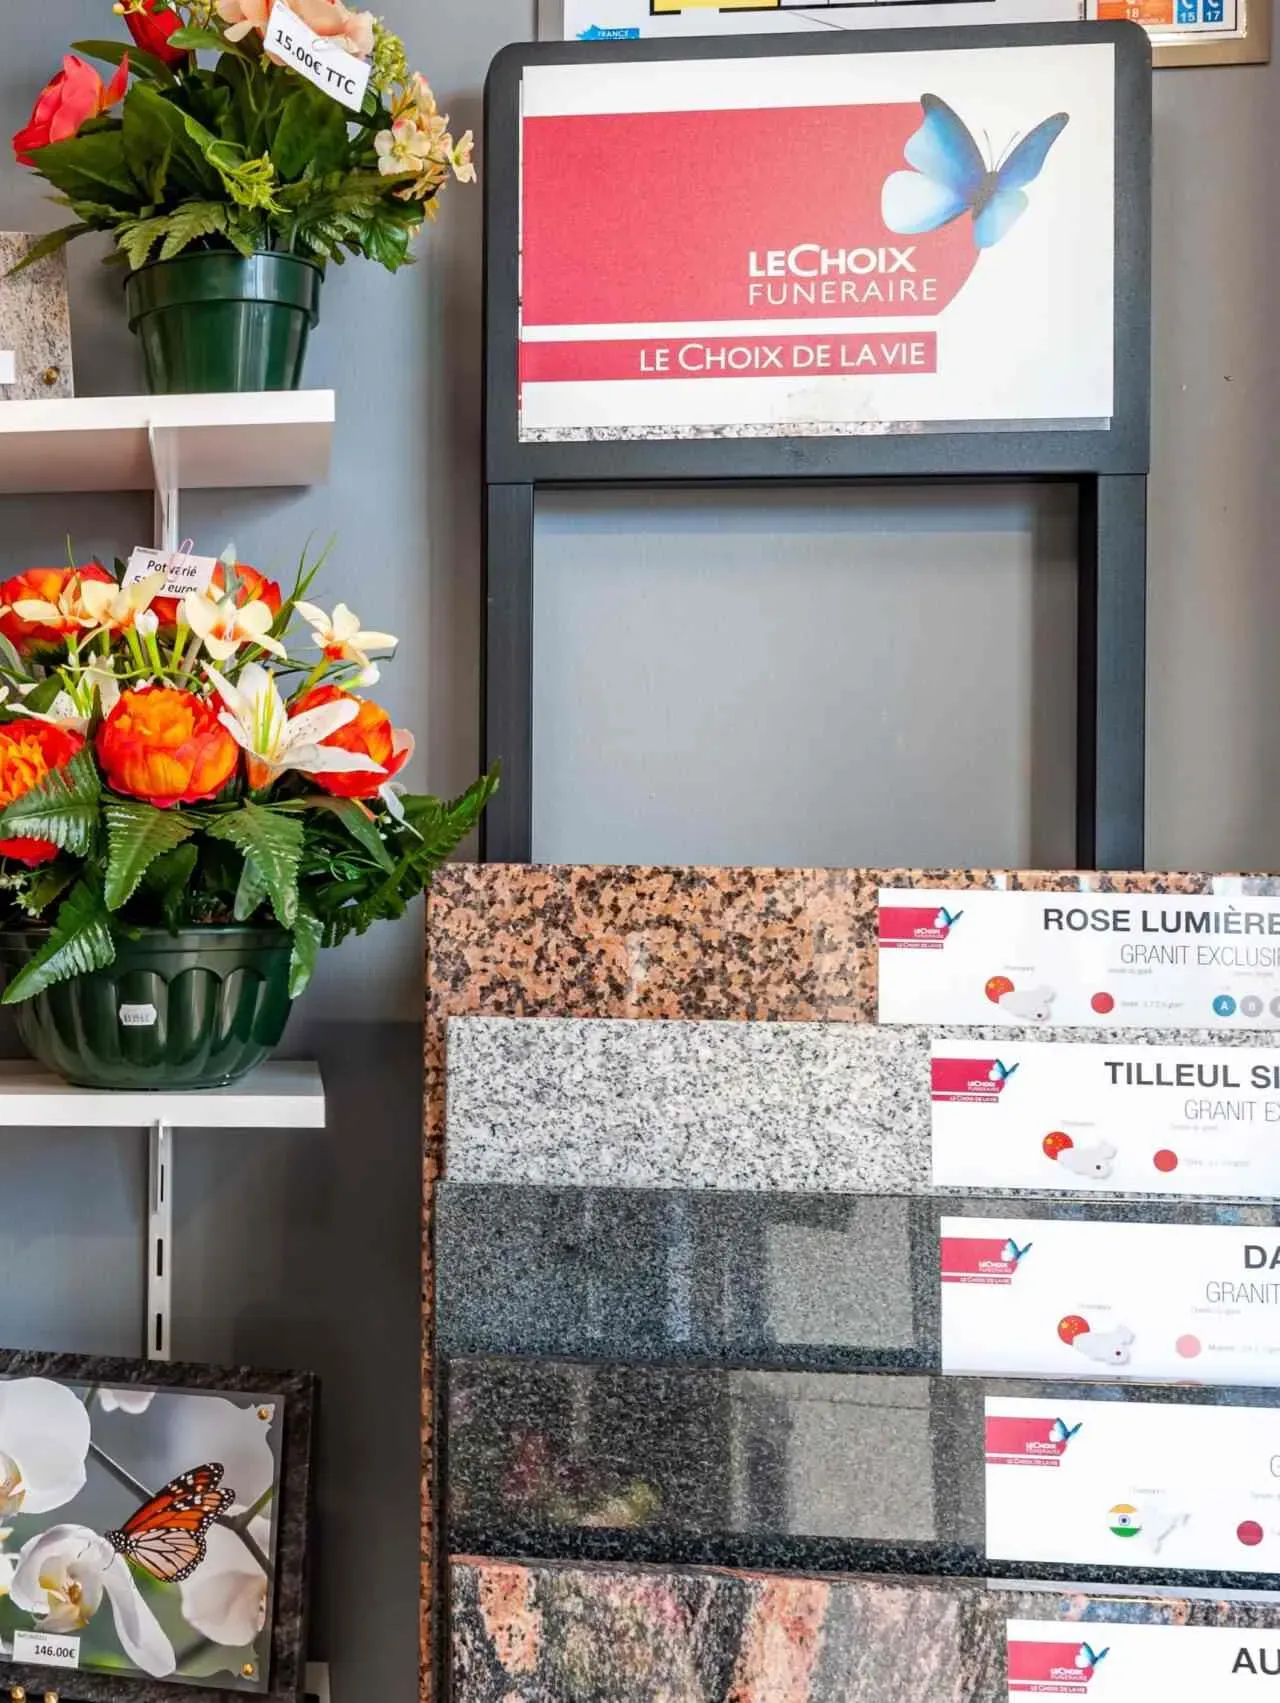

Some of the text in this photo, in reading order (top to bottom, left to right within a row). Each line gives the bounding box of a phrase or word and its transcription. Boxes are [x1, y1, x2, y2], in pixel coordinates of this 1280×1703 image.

[1126, 7, 1139, 18] 18
[1180, 12, 1195, 22] 15
[1207, 10, 1219, 20] 17
[275, 29, 356, 95] 15.00€ TTC
[749, 278, 937, 306] FUNERAIRE
[639, 342, 925, 372] LE CHOIX DE LA VIE
[147, 559, 168, 573] Pot
[1043, 904, 1280, 936] ROSE LUMIÈRE
[1120, 944, 1280, 968] GRANIT EXCLUSI
[1104, 1061, 1240, 1088] TILLEUL
[1184, 1099, 1257, 1123] GRANIT
[1205, 1281, 1280, 1305] GRANIT
[35, 1644, 76, 1658] 146.00€
